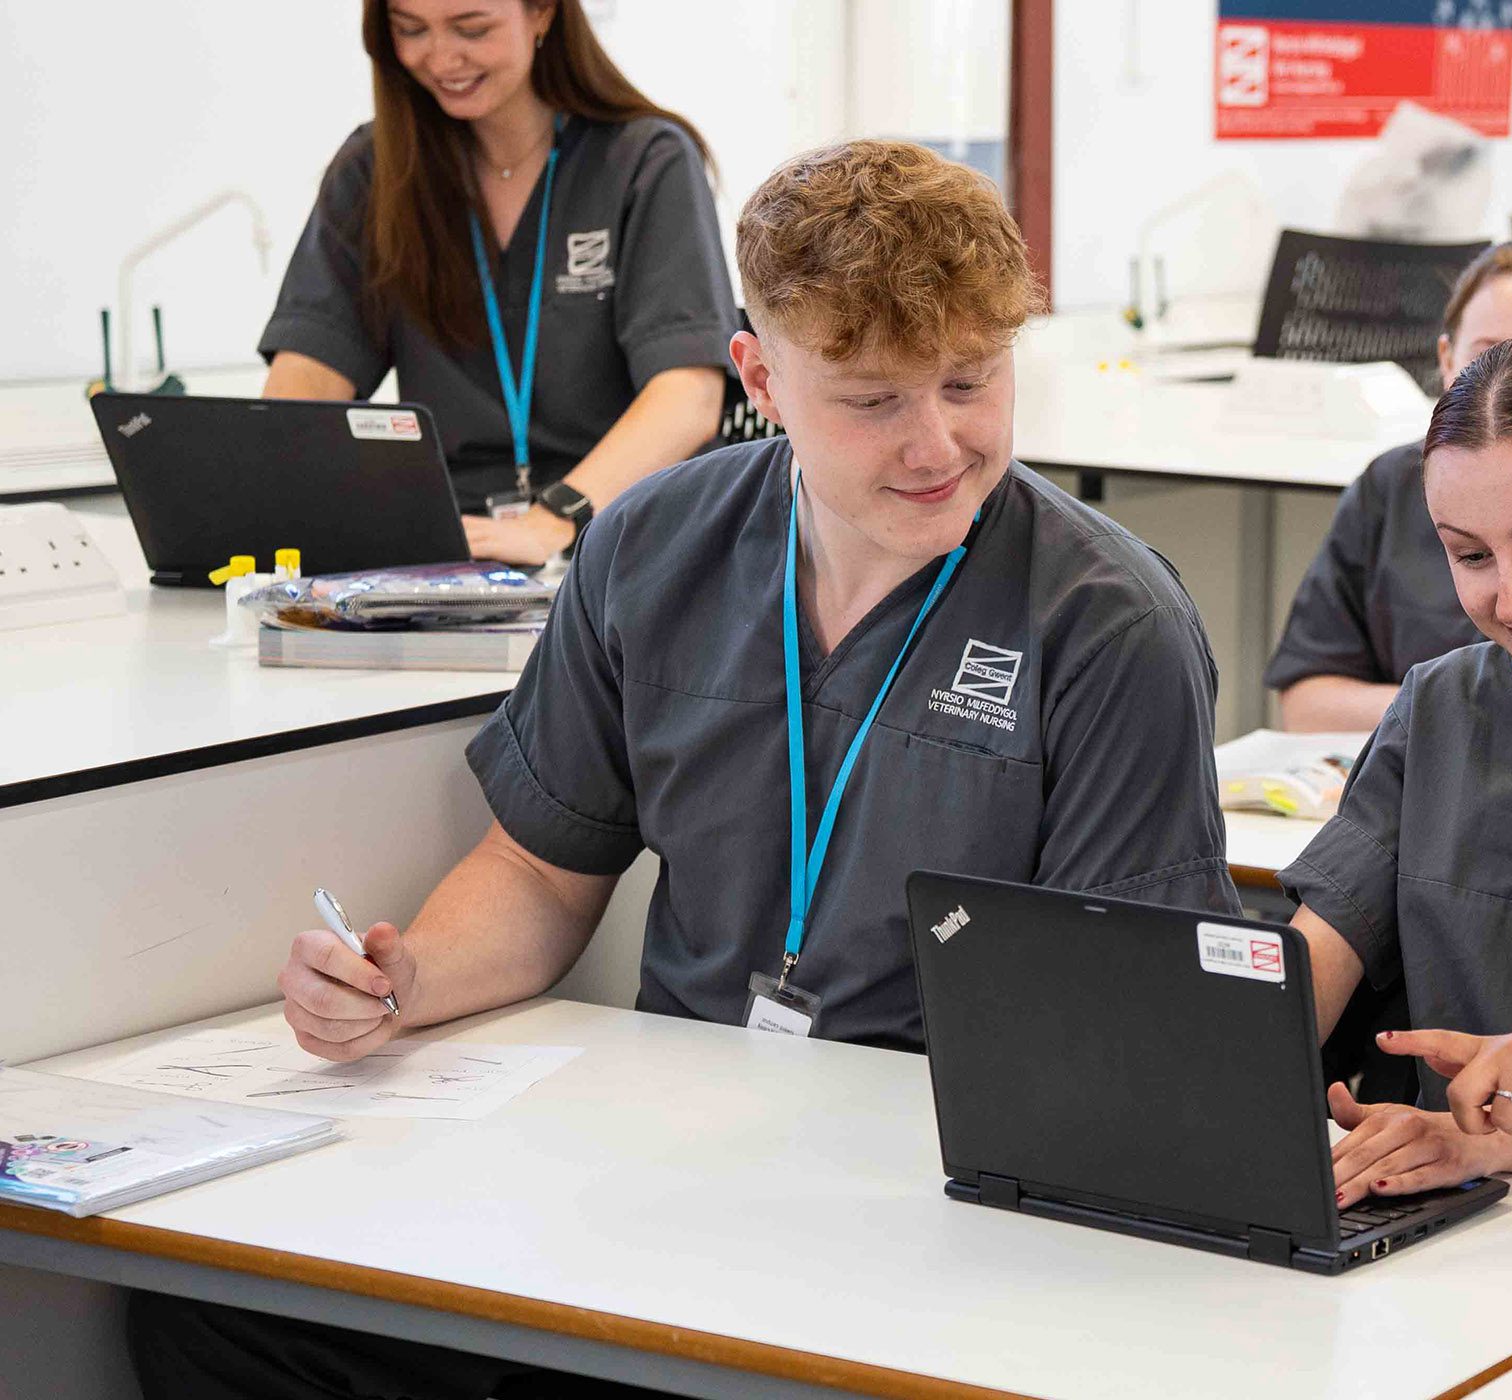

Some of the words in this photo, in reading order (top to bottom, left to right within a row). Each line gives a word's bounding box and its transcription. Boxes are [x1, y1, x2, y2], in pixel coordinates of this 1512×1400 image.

[965, 662, 987, 676] Coleg
[989, 668, 1013, 682] Gwent
[928, 700, 980, 721] VETERINARY
[980, 713, 1015, 732] NURSING
[931, 689, 964, 705] NYRSIO
[966, 698, 1017, 720] MILFEDDYGOL
[930, 904, 971, 944] ThinkPad
